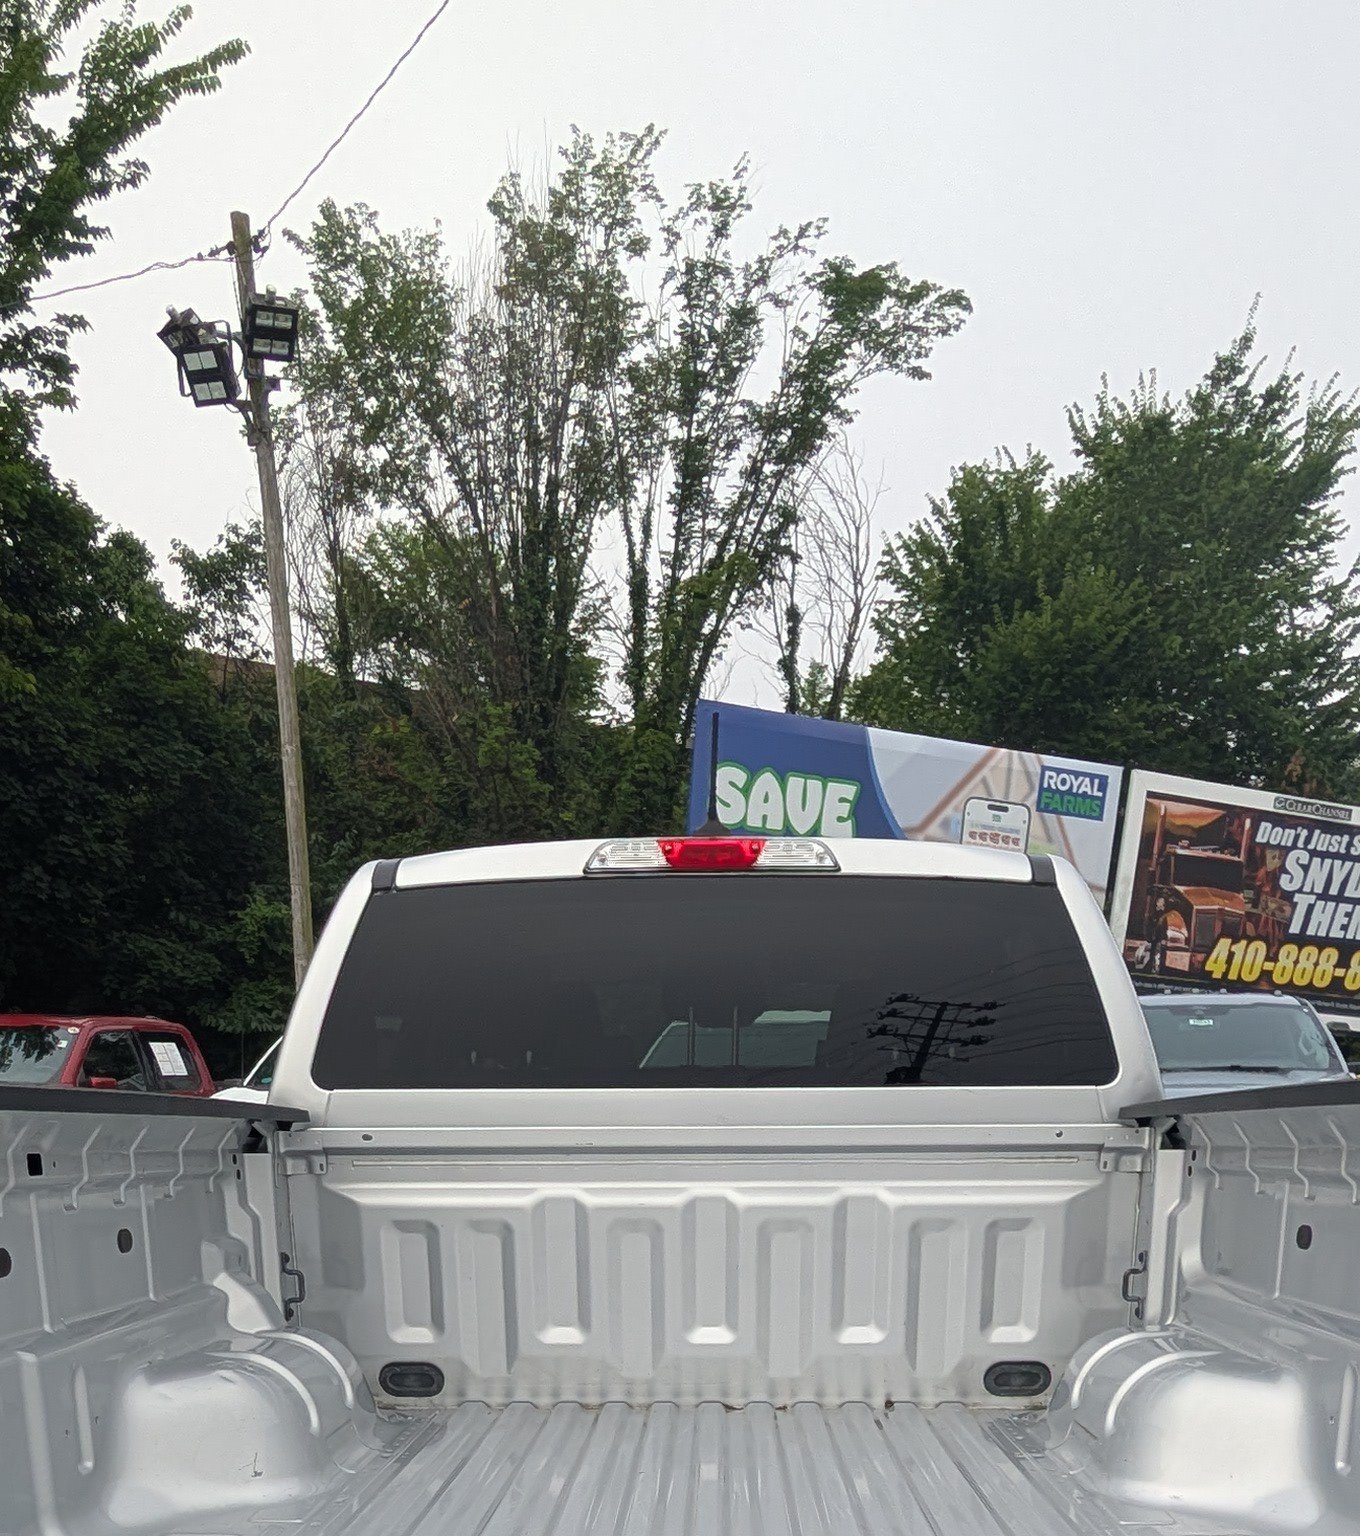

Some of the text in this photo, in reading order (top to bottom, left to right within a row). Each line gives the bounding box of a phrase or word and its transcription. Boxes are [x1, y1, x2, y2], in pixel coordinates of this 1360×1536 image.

[1043, 770, 1103, 797] ROYAL
[715, 763, 859, 838] SAVE
[1041, 791, 1102, 817] FARMS
[1255, 821, 1309, 849] Don't
[1307, 829, 1350, 854] Just
